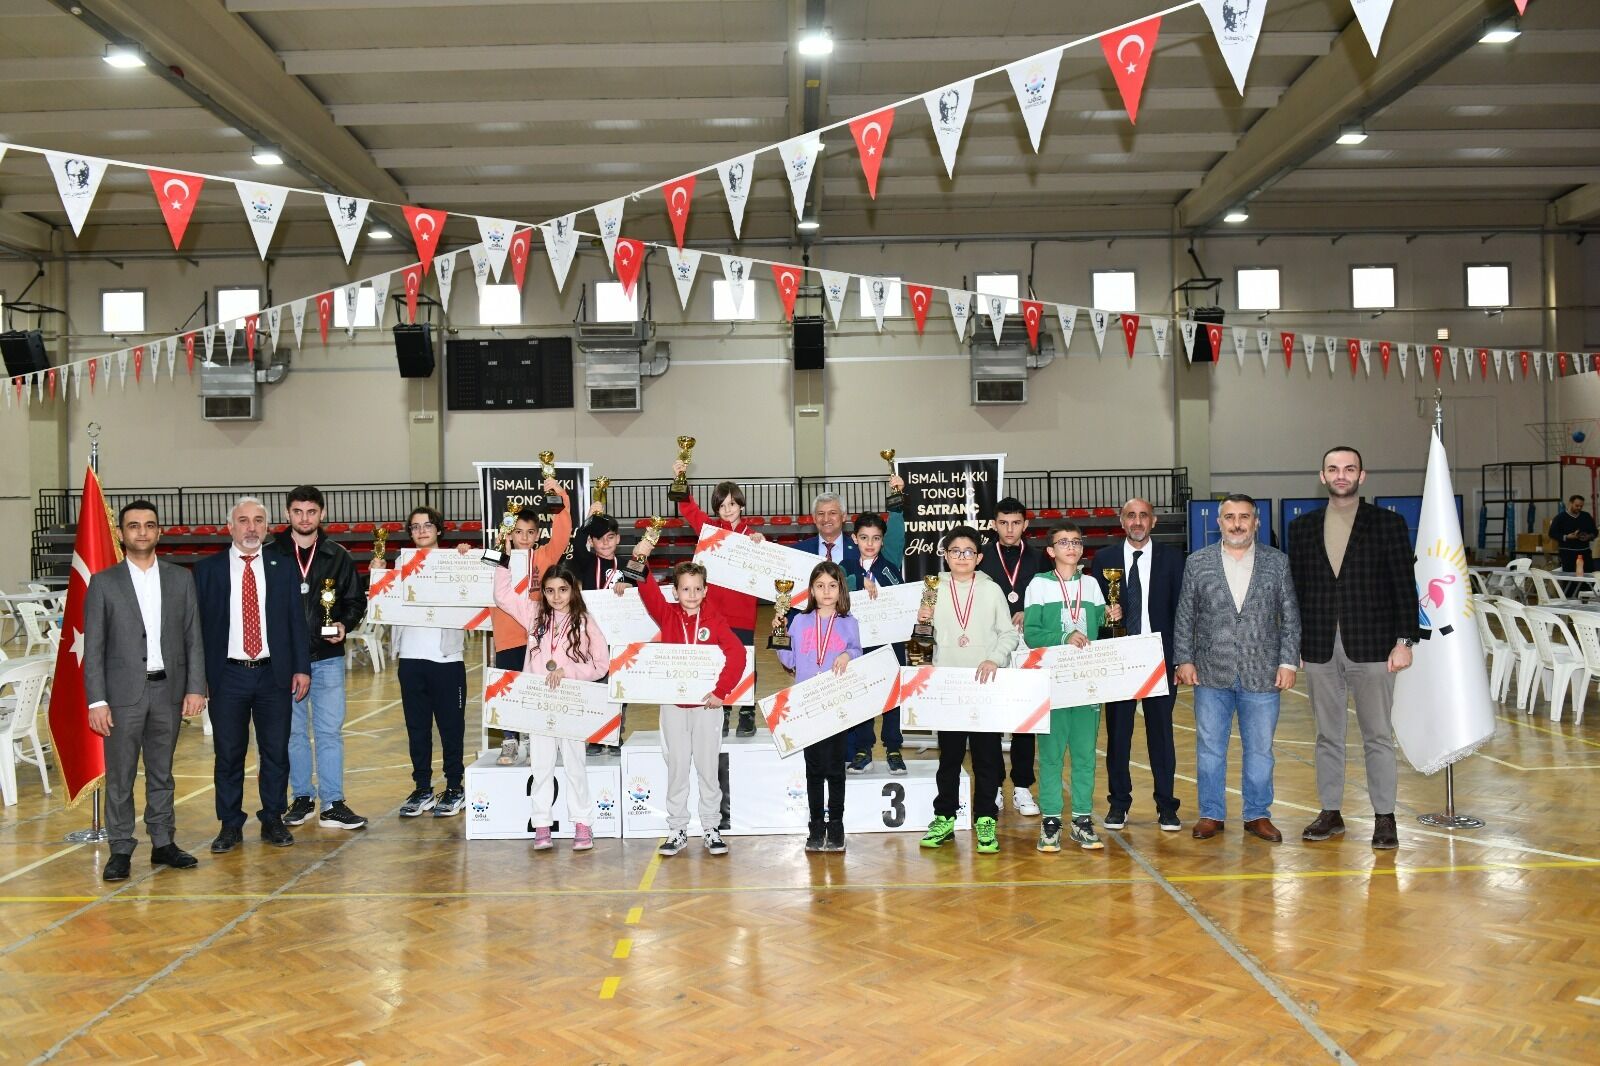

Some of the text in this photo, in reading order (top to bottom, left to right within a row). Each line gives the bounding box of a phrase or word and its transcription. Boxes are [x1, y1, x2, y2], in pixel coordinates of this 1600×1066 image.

[493, 477, 574, 491] İSMAİL HKKI
[908, 470, 988, 485] İSMAİL HAKKI
[882, 782, 906, 828] 3
